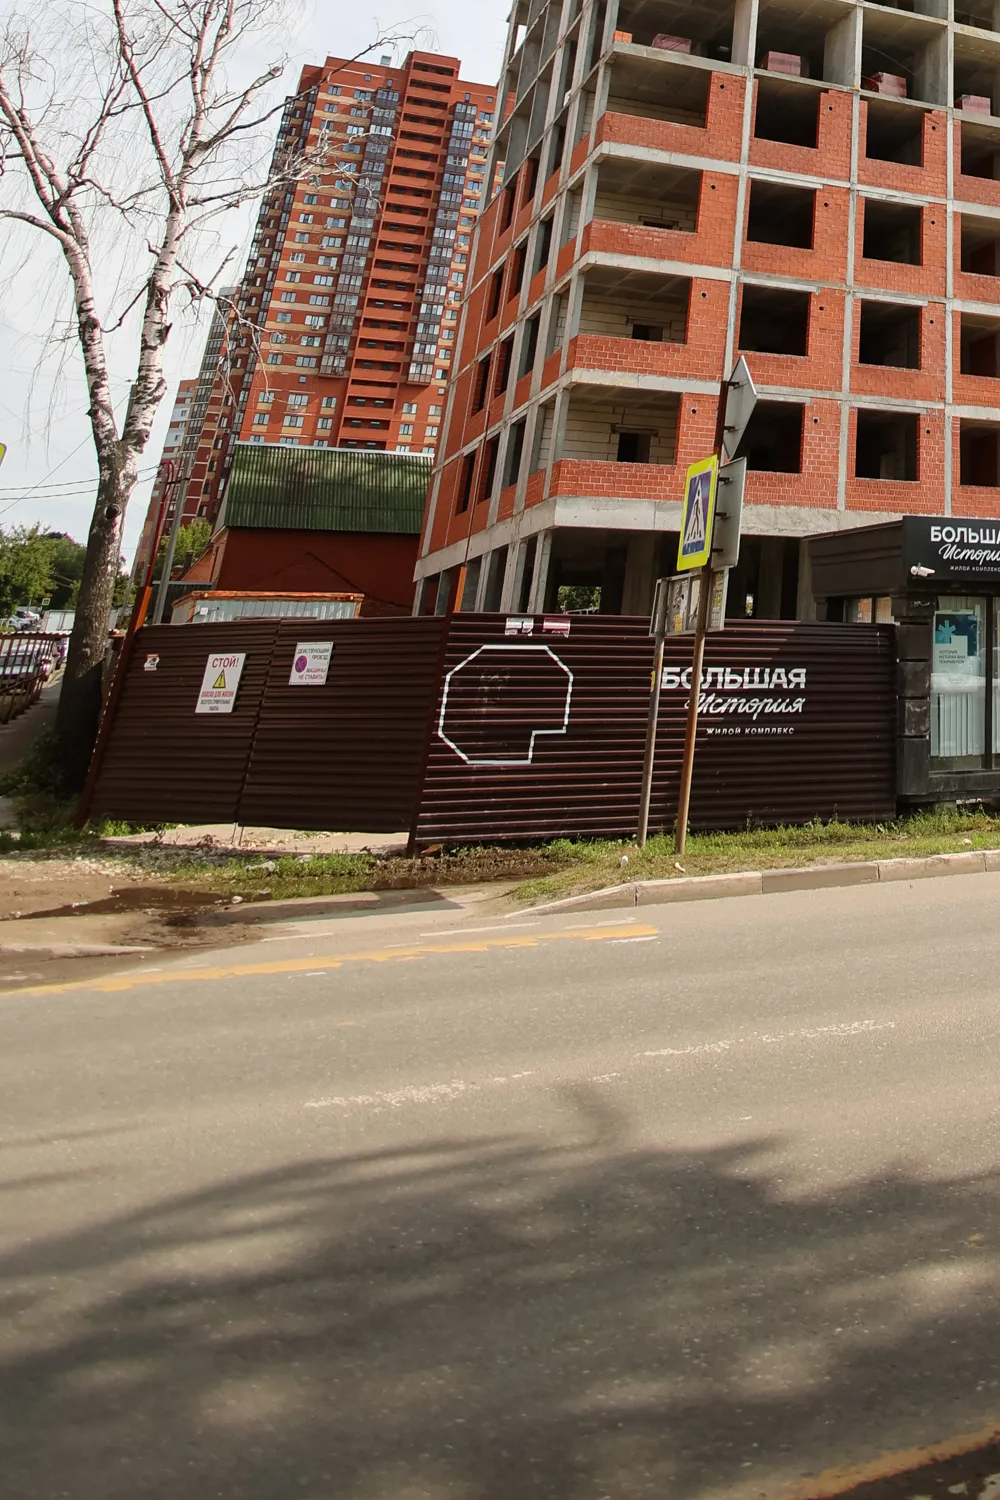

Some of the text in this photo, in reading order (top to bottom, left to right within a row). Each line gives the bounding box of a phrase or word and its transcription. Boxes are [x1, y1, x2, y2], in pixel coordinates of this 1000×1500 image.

[211, 655, 240, 668] СТОЙ!
[661, 666, 807, 689] БОЛЬШАЯ
[684, 693, 806, 721] История
[706, 727, 795, 735] ЖИЛОЙ КОМПЛЕКС
